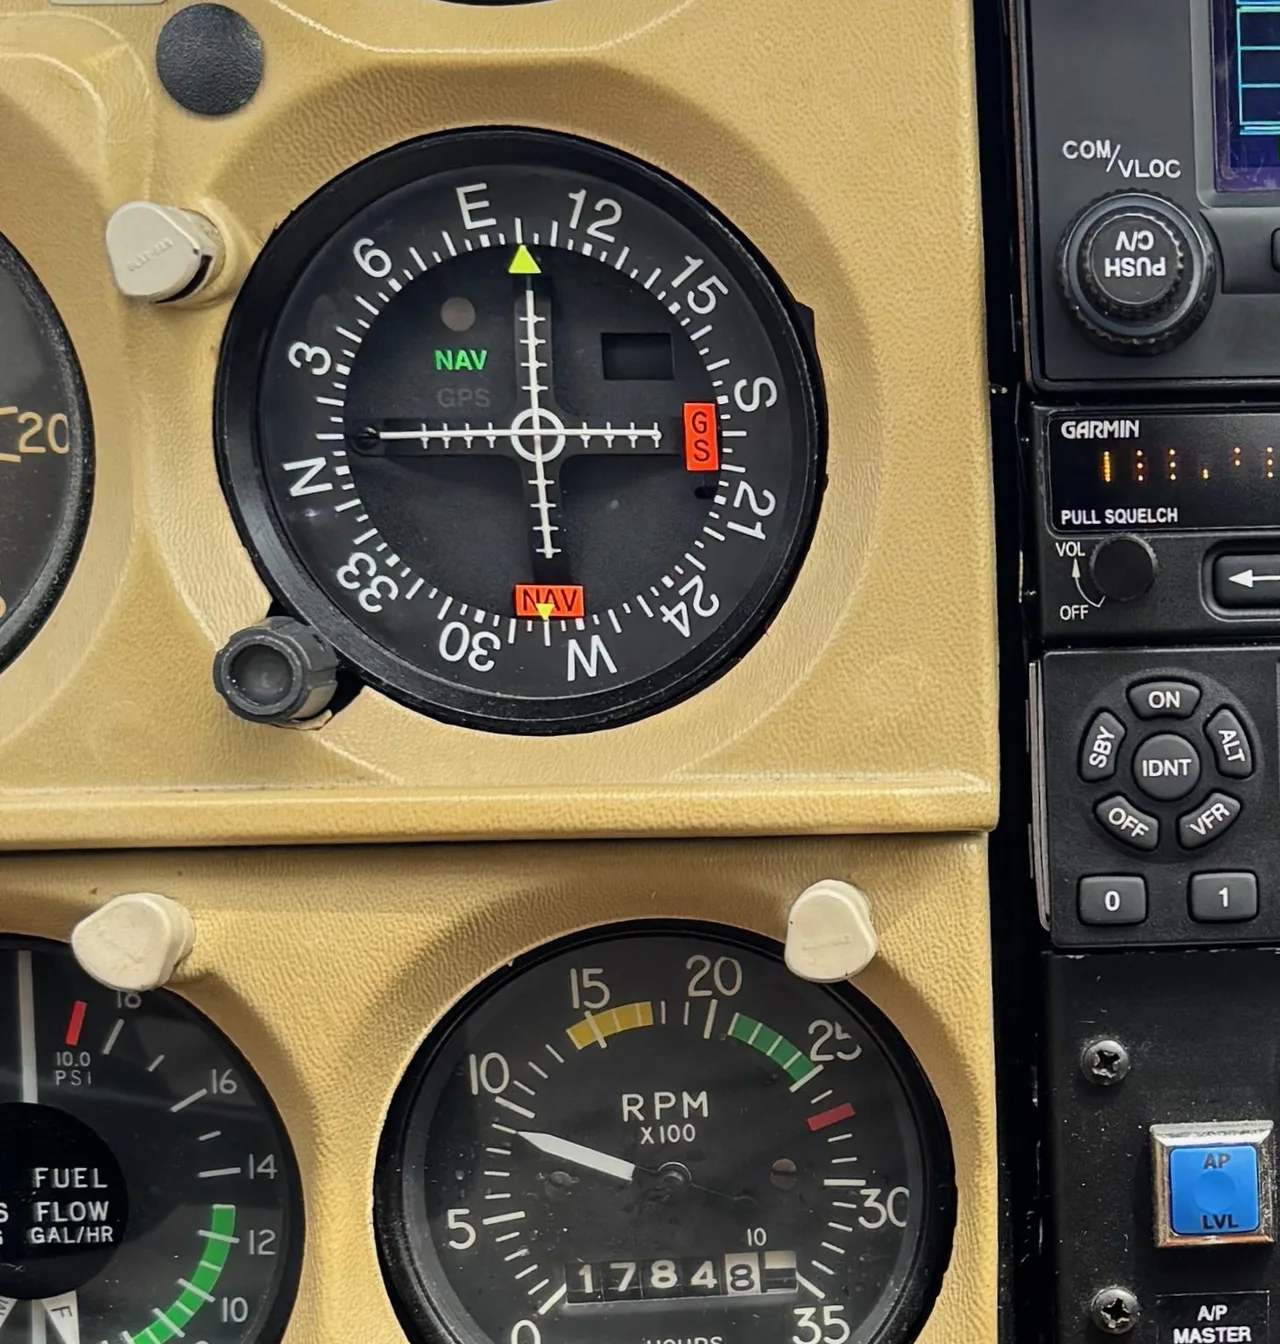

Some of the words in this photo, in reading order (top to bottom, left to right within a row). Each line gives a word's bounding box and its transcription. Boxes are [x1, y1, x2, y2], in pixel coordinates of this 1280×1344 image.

[434, 350, 487, 370] NAV
[1061, 420, 1139, 439] GARMIN
[1062, 510, 1101, 526] PULL
[1105, 508, 1178, 524] SQUELCH
[1142, 760, 1190, 778] IDNT
[622, 1093, 708, 1122] RPM
[36, 1168, 108, 1188] FUEL
[36, 1201, 110, 1222] FLOW
[31, 1226, 114, 1244] GAL/HR
[1197, 1305, 1228, 1323] A/P
[1174, 1326, 1251, 1344] MASTER
